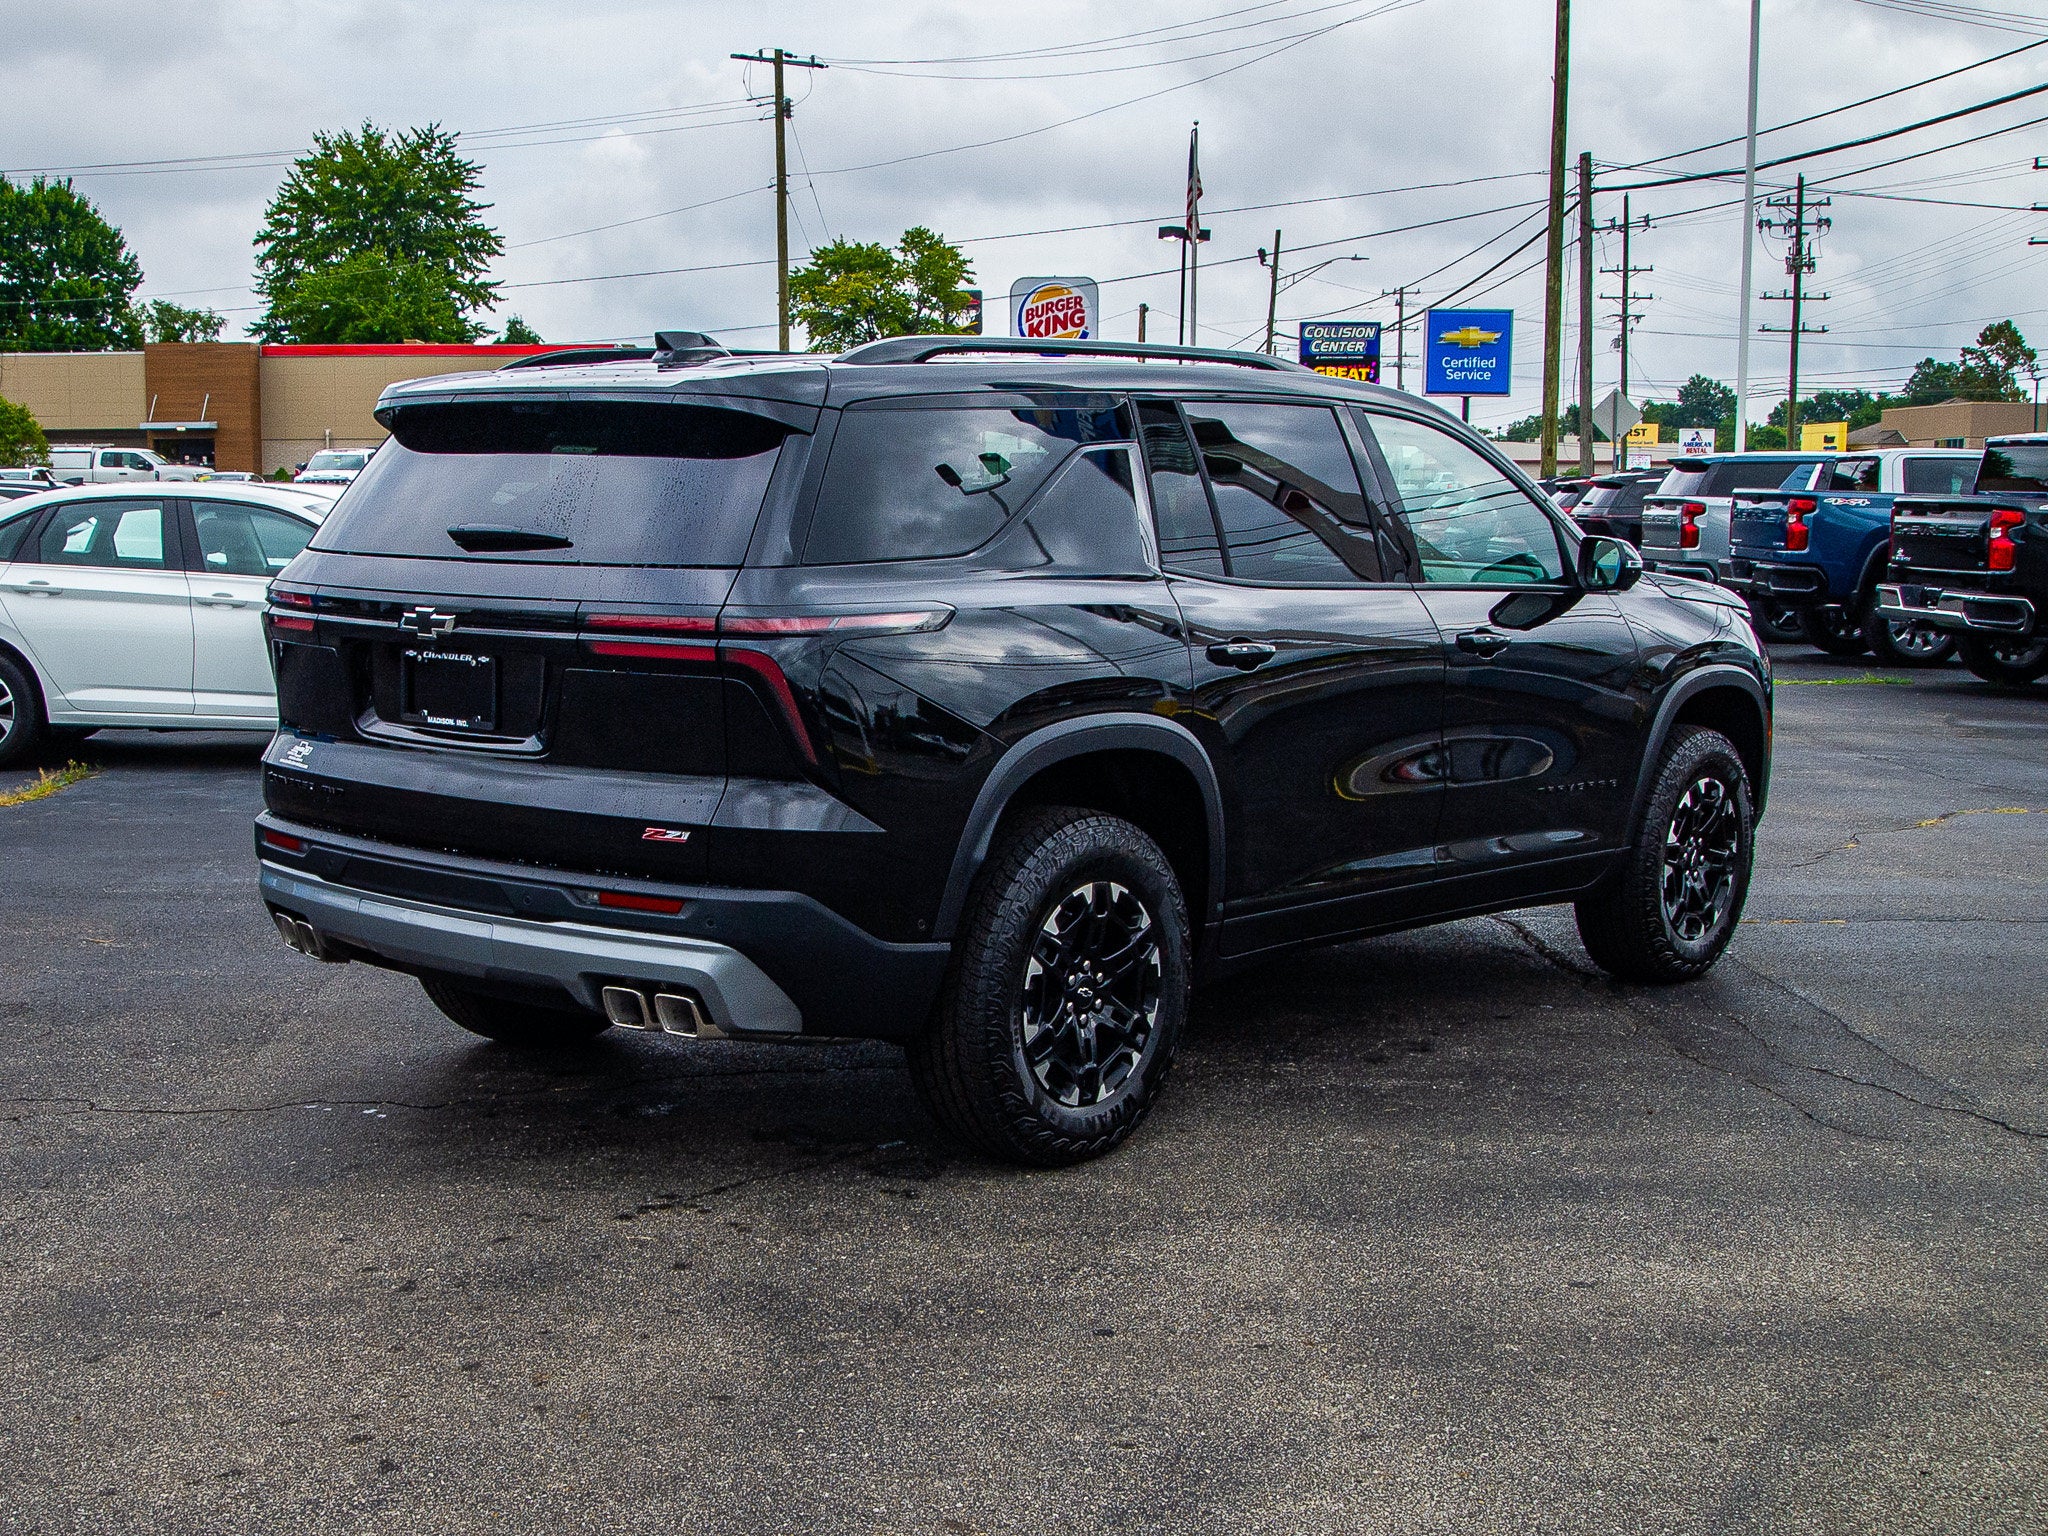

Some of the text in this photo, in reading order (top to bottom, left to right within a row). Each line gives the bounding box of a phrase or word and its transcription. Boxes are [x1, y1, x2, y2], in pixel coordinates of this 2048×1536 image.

[1025, 296, 1083, 323] BURGER
[1028, 308, 1085, 338] KING
[1304, 326, 1376, 338] COLLISION
[1311, 339, 1365, 352] CENTER
[1442, 356, 1496, 368] Certified
[1313, 366, 1370, 381] GREAT
[1446, 368, 1491, 380] Service
[1627, 428, 1647, 437] RST
[422, 650, 473, 662] CHANDLER
[642, 827, 691, 842] Z71
